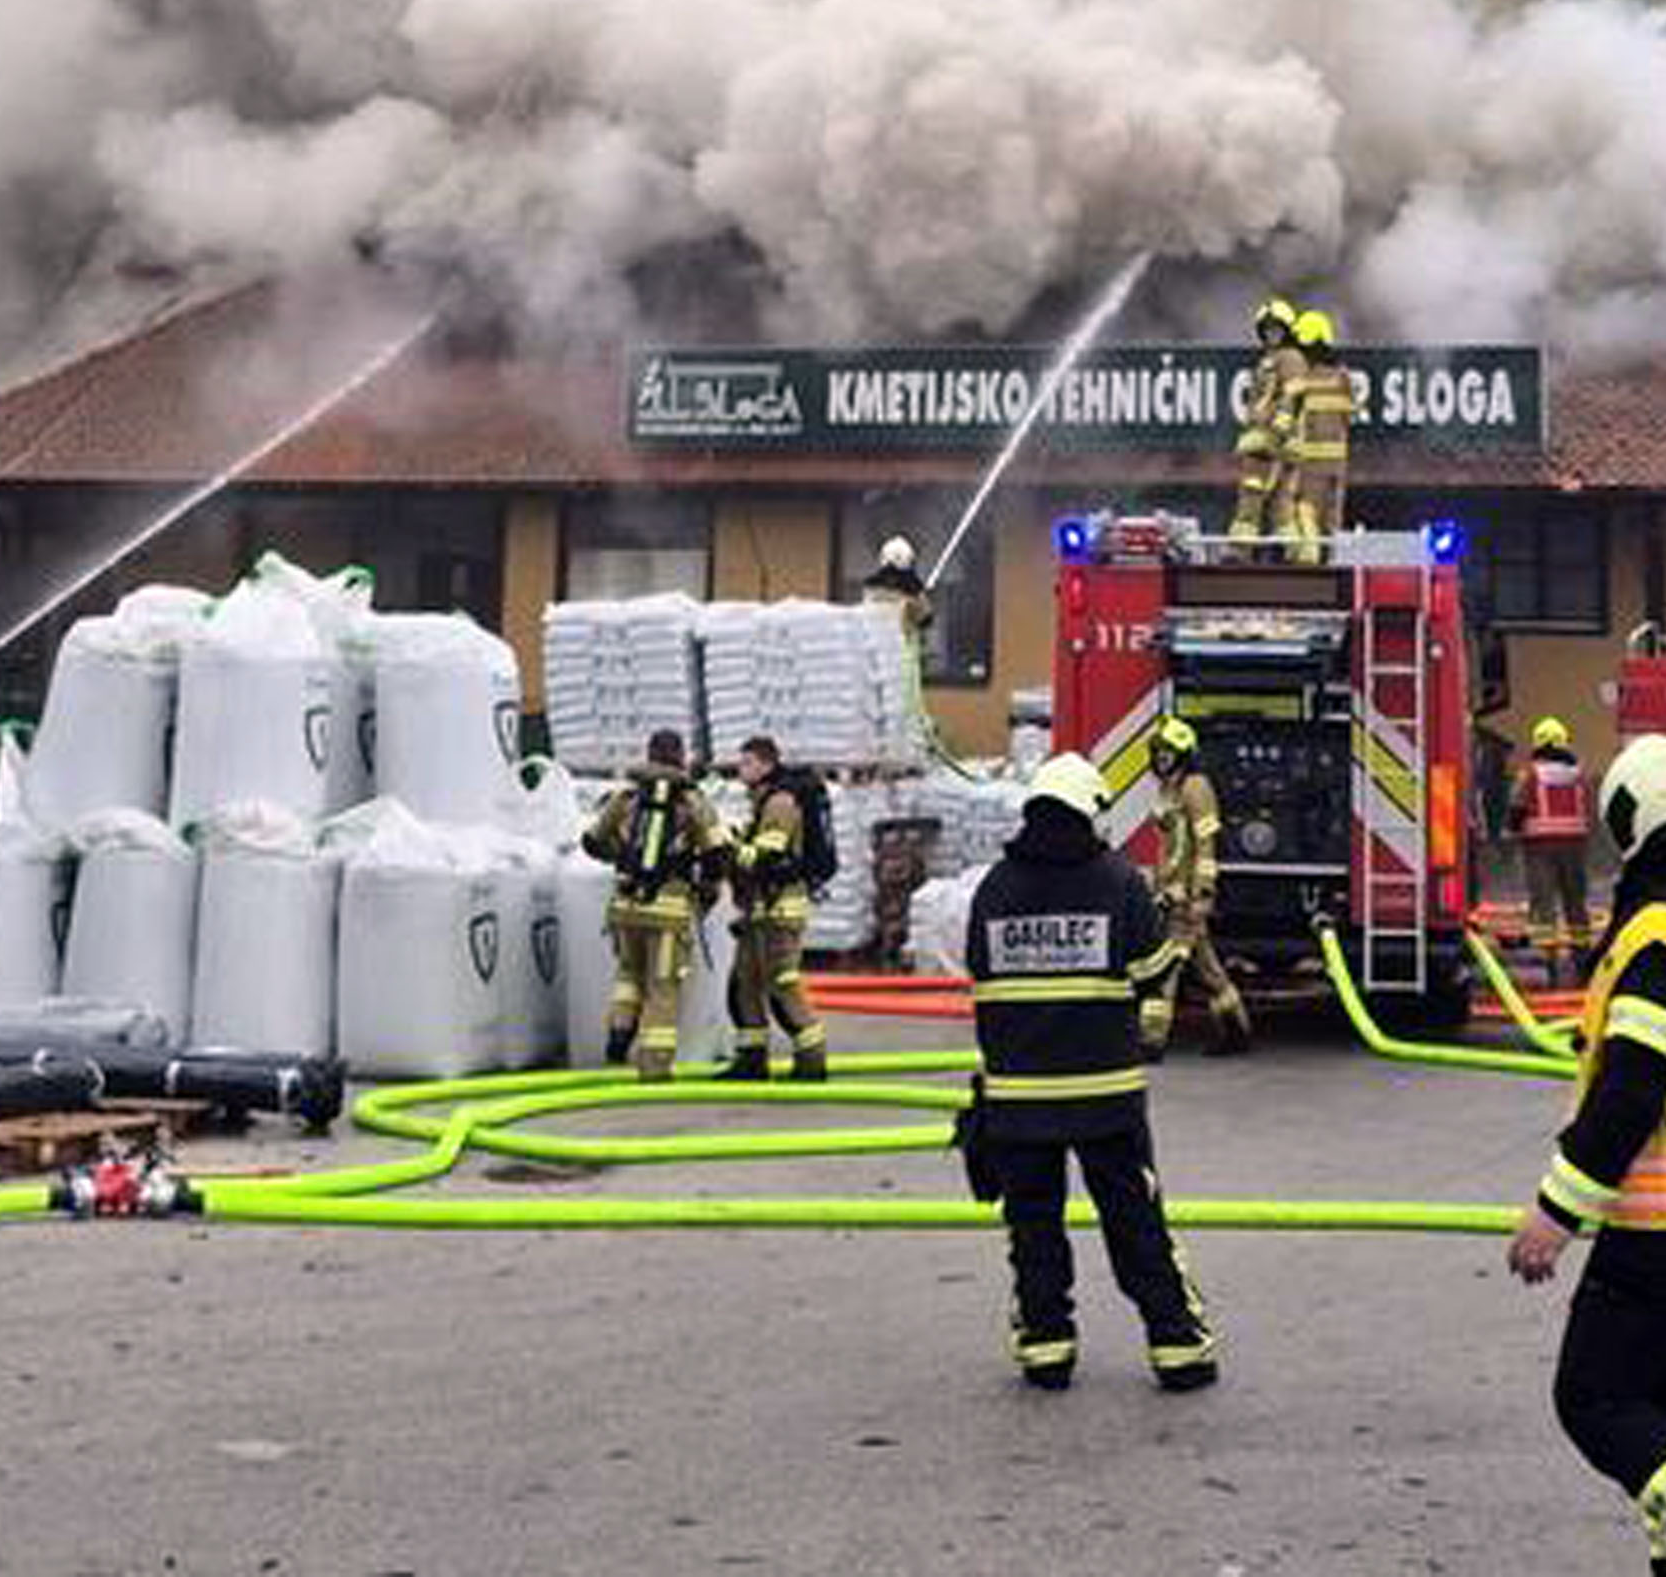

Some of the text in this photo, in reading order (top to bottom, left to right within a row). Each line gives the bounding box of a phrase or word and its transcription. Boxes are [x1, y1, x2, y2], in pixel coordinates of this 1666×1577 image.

[829, 370, 1030, 424] KMETIJSKO
[1383, 369, 1517, 424] SLOGA
[1096, 623, 1154, 652] 112
